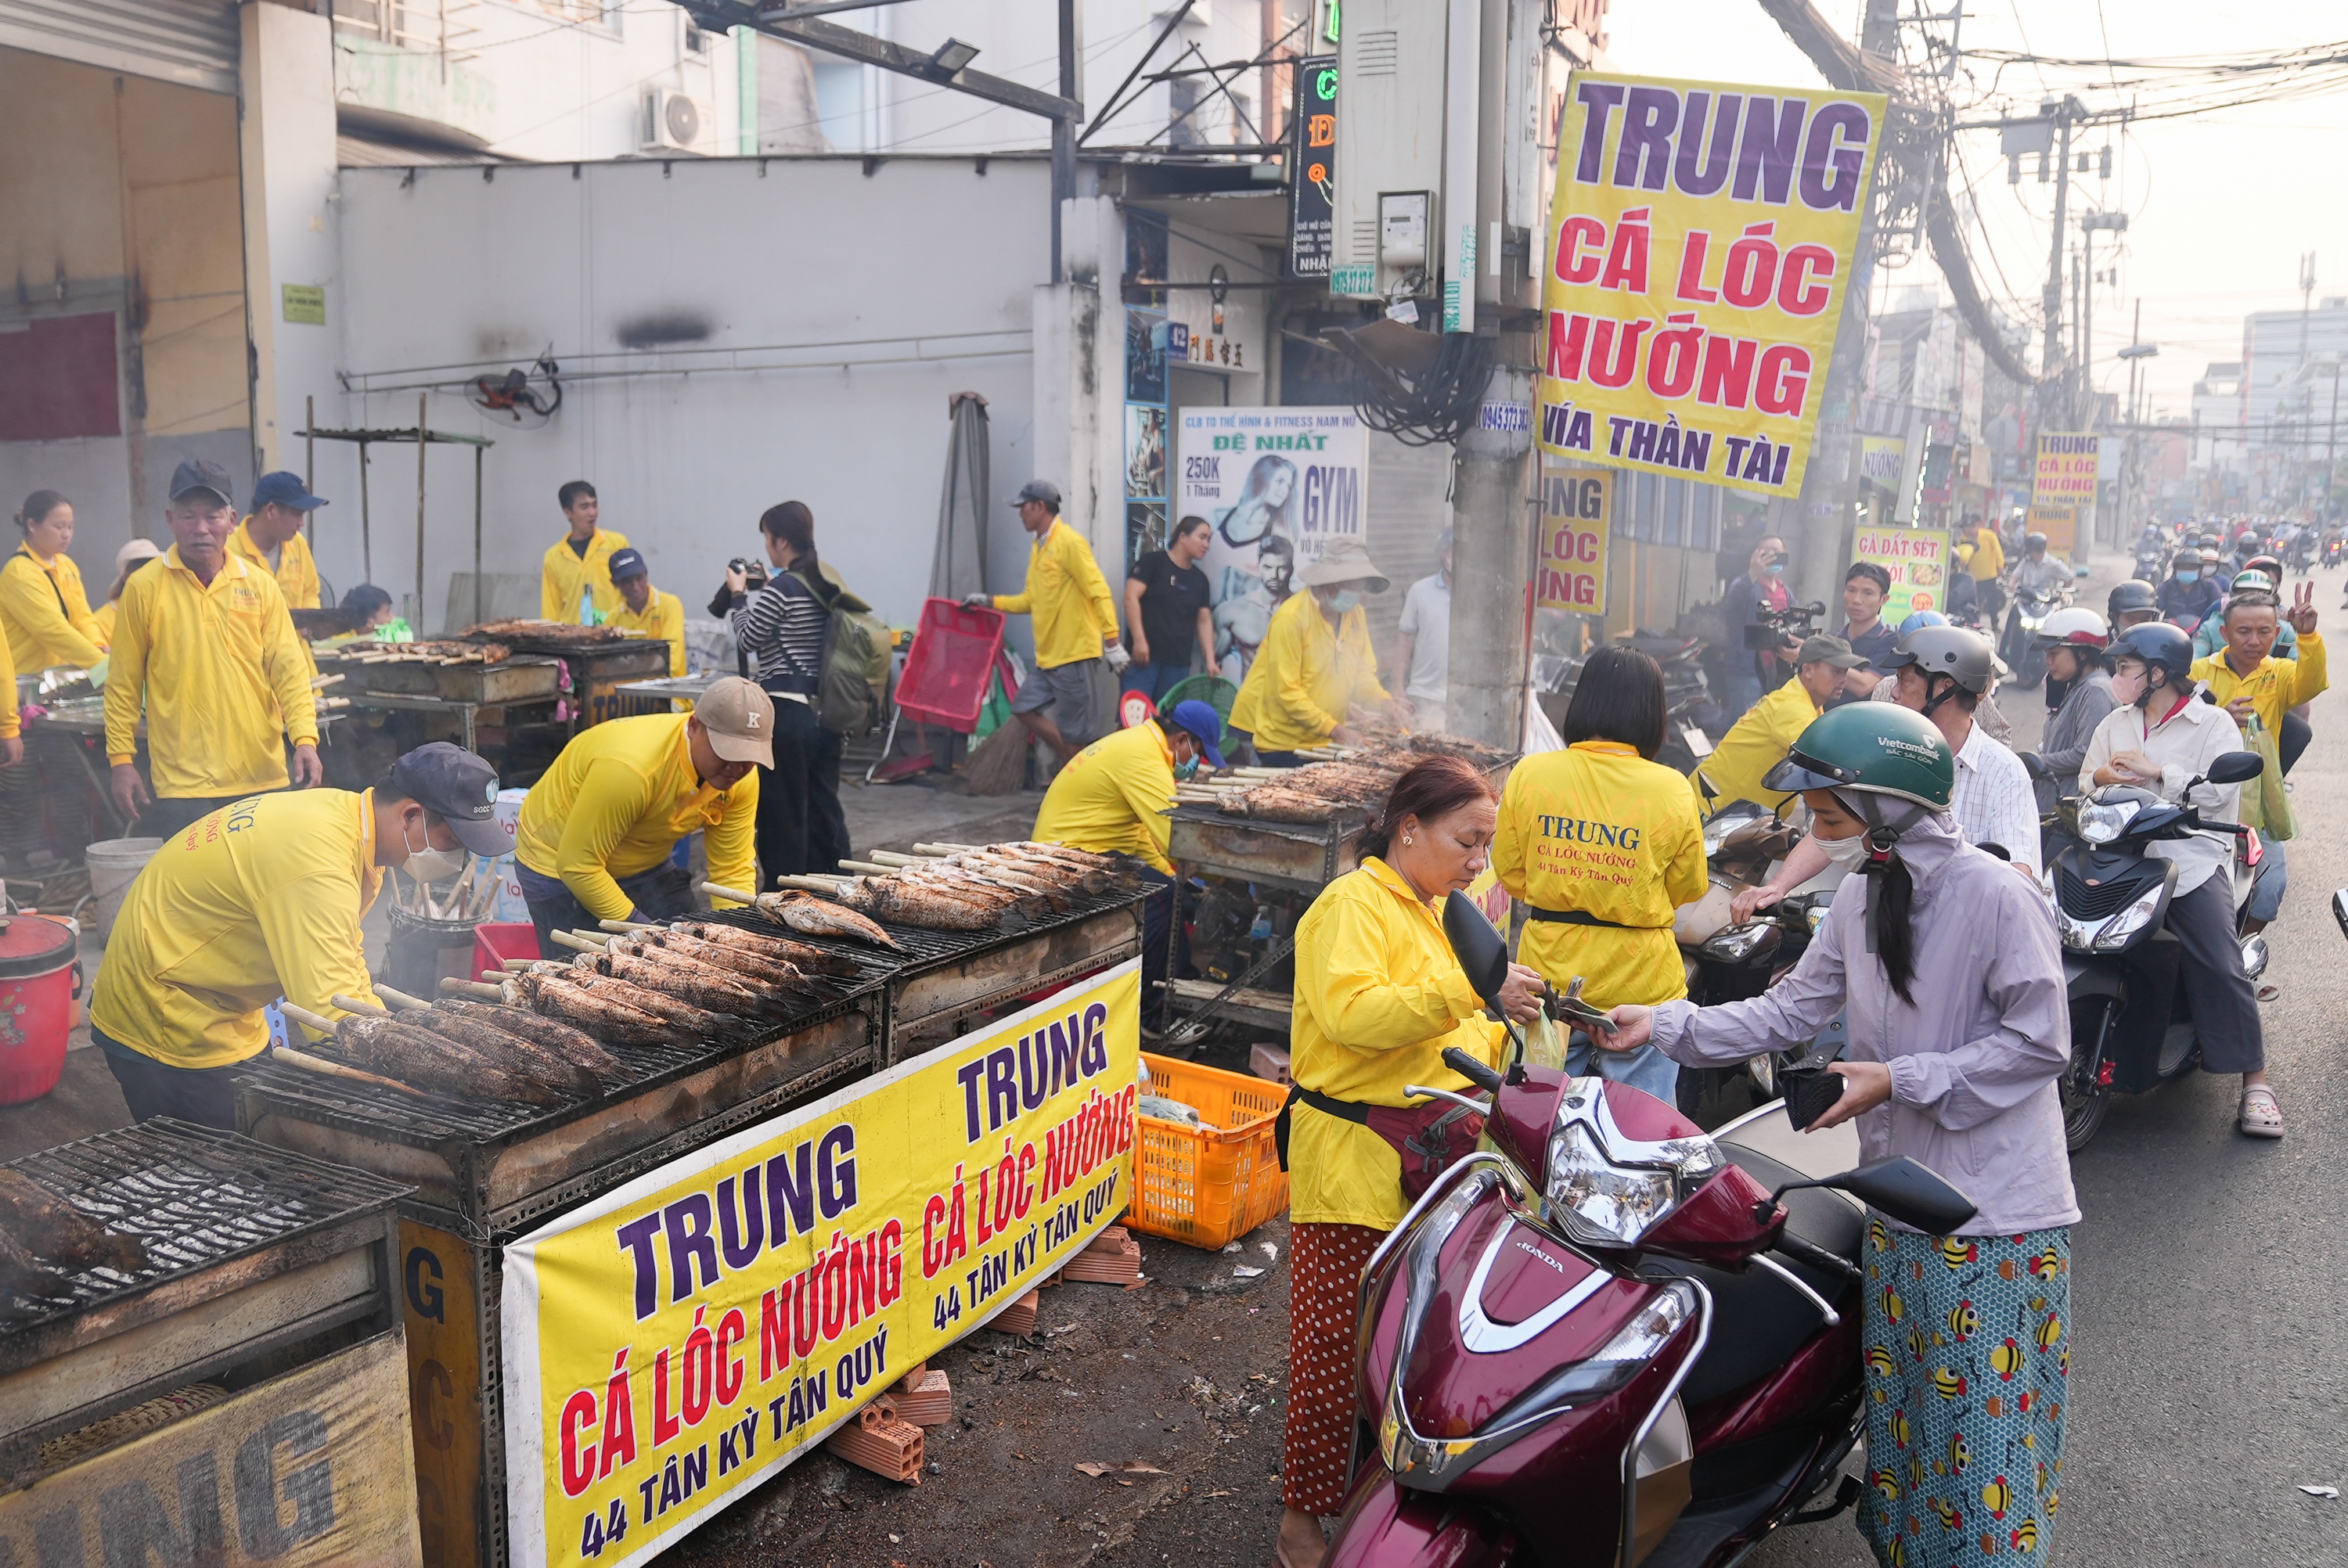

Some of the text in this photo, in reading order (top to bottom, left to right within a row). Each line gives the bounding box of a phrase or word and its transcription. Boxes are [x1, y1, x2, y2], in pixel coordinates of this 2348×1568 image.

[1577, 83, 1869, 211] TRUNG
[1556, 207, 1651, 293] CÁ
[1676, 221, 1835, 316] LÓC
[1171, 326, 1187, 347] 42
[1546, 311, 1812, 418] NƯỚNG
[1186, 416, 1203, 428] CLB
[1264, 417, 1272, 428] &
[1274, 415, 1313, 428] FITNESS
[1316, 415, 1339, 428] NAM
[1213, 430, 1329, 454] ĐỆ NHẤT
[1543, 401, 1791, 486] VÍA THẦN TÀI
[2040, 435, 2098, 455] TRUNG
[1187, 456, 1221, 480] 250K
[1194, 483, 1221, 499] Tháng
[2037, 477, 2094, 491] NƯỚNG
[1303, 465, 1358, 534] GYM
[1859, 533, 1878, 554] GÀ
[1912, 536, 1939, 558] SÉT
[747, 711, 762, 729] K
[1878, 736, 1941, 761] Vietcombank
[473, 805, 490, 815] SGCC
[1537, 815, 1640, 852] TRUNG
[1554, 845, 1582, 861] LÓC
[1585, 852, 1637, 869] NƯỚNG
[1547, 863, 1567, 875] Tân
[1570, 866, 1584, 879] Kỳ
[1586, 868, 1608, 882] Tân
[1612, 872, 1634, 887] Quý
[957, 1002, 1108, 1145] TRUNG
[922, 1084, 1136, 1281] CÁ LÓC NƯỚNG
[618, 1124, 858, 1321] TRUNG
[933, 1171, 1119, 1332] 44 TÂN KỲ TÂN QUÝ
[1516, 1241, 1565, 1275] HONDA
[560, 1217, 903, 1498] CÁ LÓC NƯỚNG
[581, 1323, 888, 1559] 44 TÂN KỲ TÂN QUÝ
